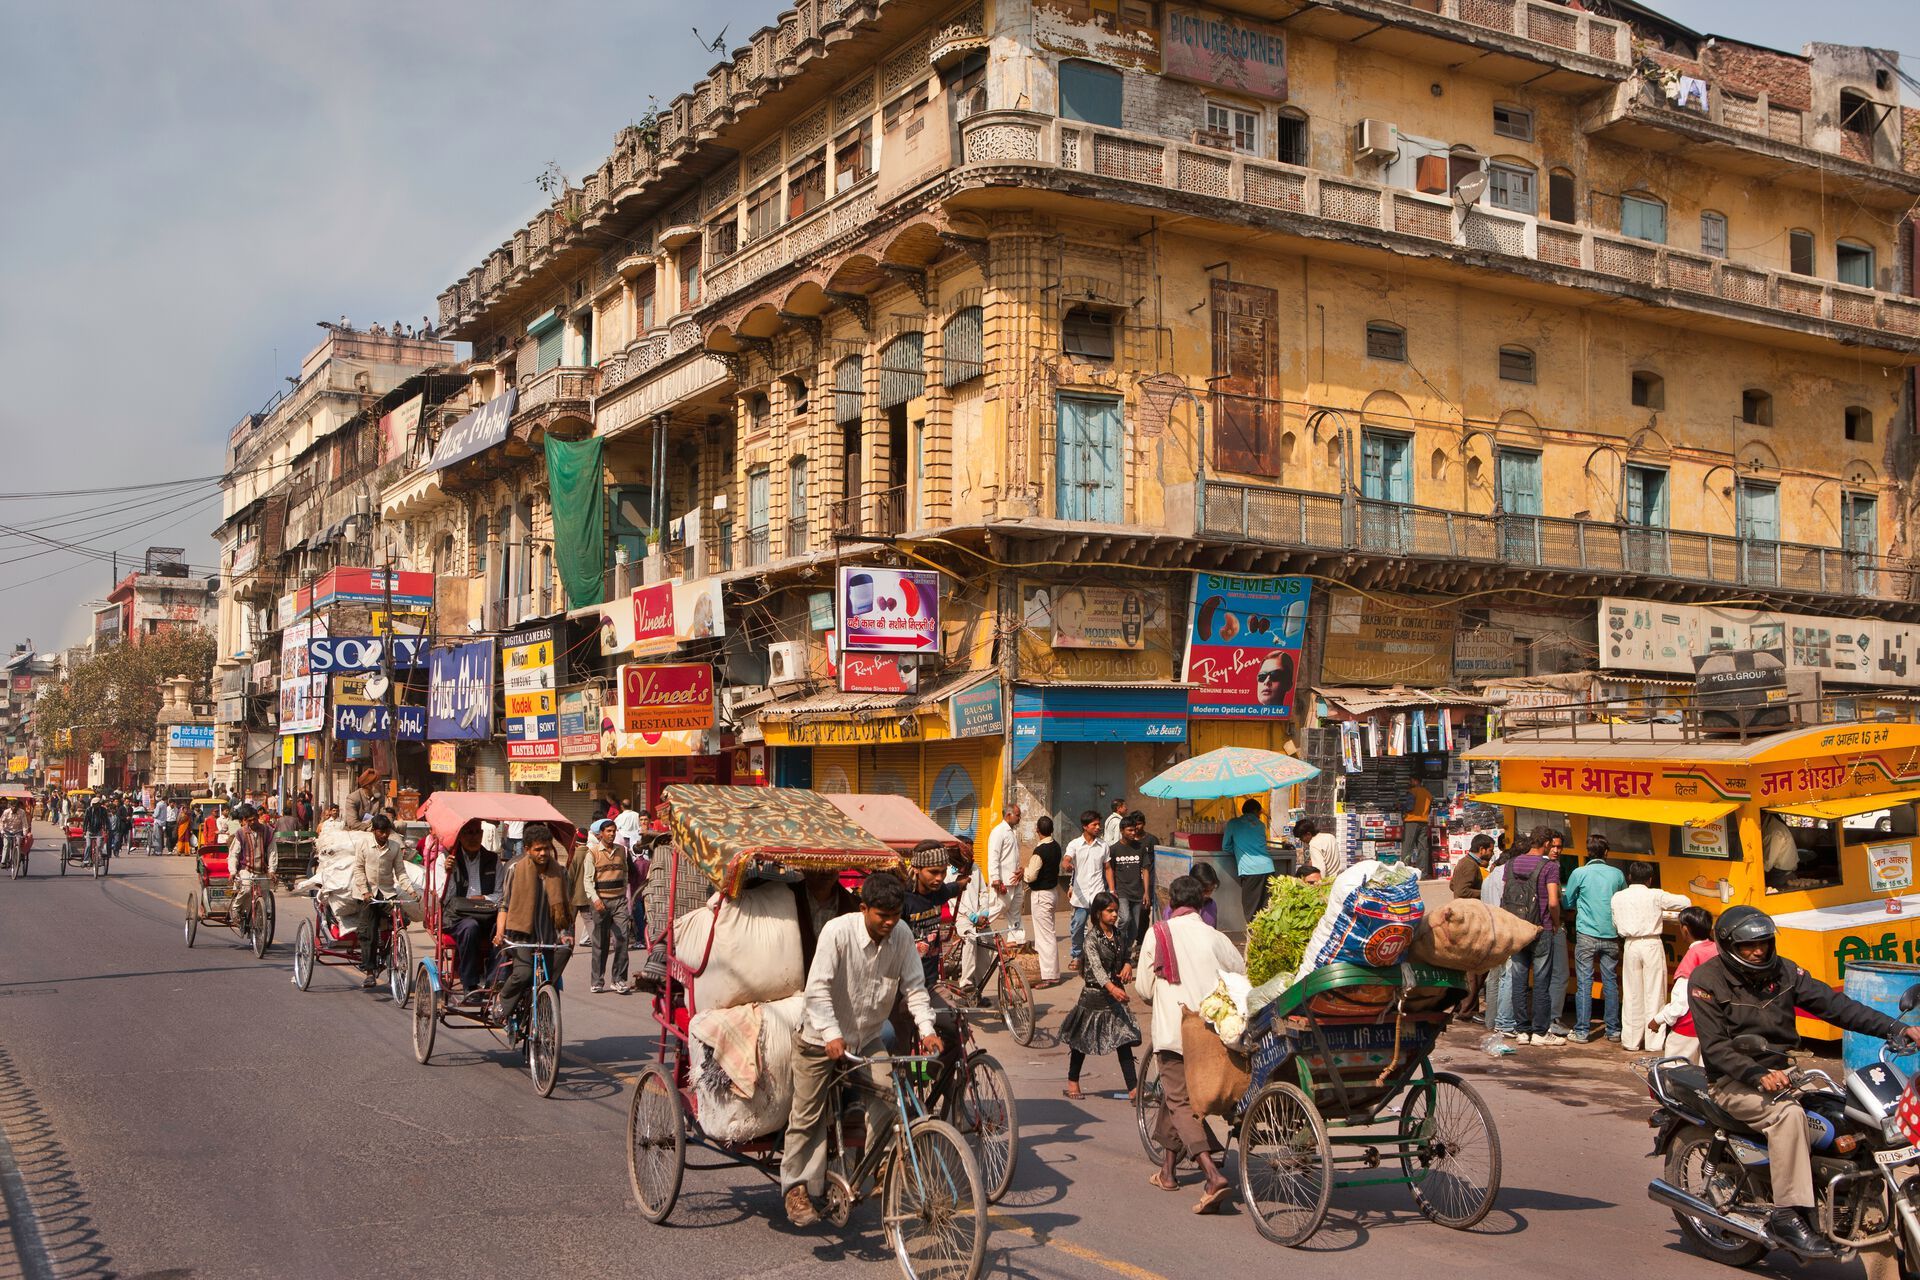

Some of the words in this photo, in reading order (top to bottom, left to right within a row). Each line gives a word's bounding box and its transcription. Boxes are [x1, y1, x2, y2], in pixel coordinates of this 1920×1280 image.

[1171, 12, 1228, 54] PICTURE
[1231, 27, 1284, 67] CORNER
[1207, 574, 1302, 594] SIEMENS
[634, 594, 673, 633] Vineet's
[876, 616, 886, 629] की
[1401, 617, 1430, 629] CONTACT
[504, 634, 525, 647] DIGITAL
[525, 628, 551, 643] CAMERAS
[1084, 627, 1122, 638] MODERN
[1375, 628, 1415, 640] DISPOSABLE
[1500, 631, 1511, 643] BY
[511, 651, 529, 667] Nikon
[847, 654, 894, 676] Ray-Ban
[1192, 648, 1261, 685] Ray-Ban
[628, 670, 710, 705] Vineet's
[511, 696, 533, 714] Kodak
[963, 703, 993, 716] BAUSCH
[1220, 706, 1246, 714] Optical
[1260, 707, 1271, 715] (P)
[631, 715, 709, 730] RESTAURANT
[973, 712, 994, 724] LOMB
[539, 721, 556, 733] SONY
[1146, 724, 1159, 736] She
[1160, 724, 1183, 736] Beauty
[180, 738, 194, 748] STATE
[1821, 734, 1835, 747] जन
[1836, 732, 1860, 747] आहार
[1861, 731, 1872, 745] 15
[511, 745, 534, 756] MASTER
[534, 744, 555, 755] COLOR
[1540, 766, 1575, 791] जन
[1580, 767, 1654, 798] आहार
[1674, 781, 1698, 796] दिल्ली
[1725, 777, 1747, 790] सरकार
[1760, 770, 1794, 797] जन
[1797, 765, 1846, 791] आहार
[1873, 858, 1886, 868] जन
[1889, 855, 1909, 865] आहार
[1381, 941, 1404, 956] 501
